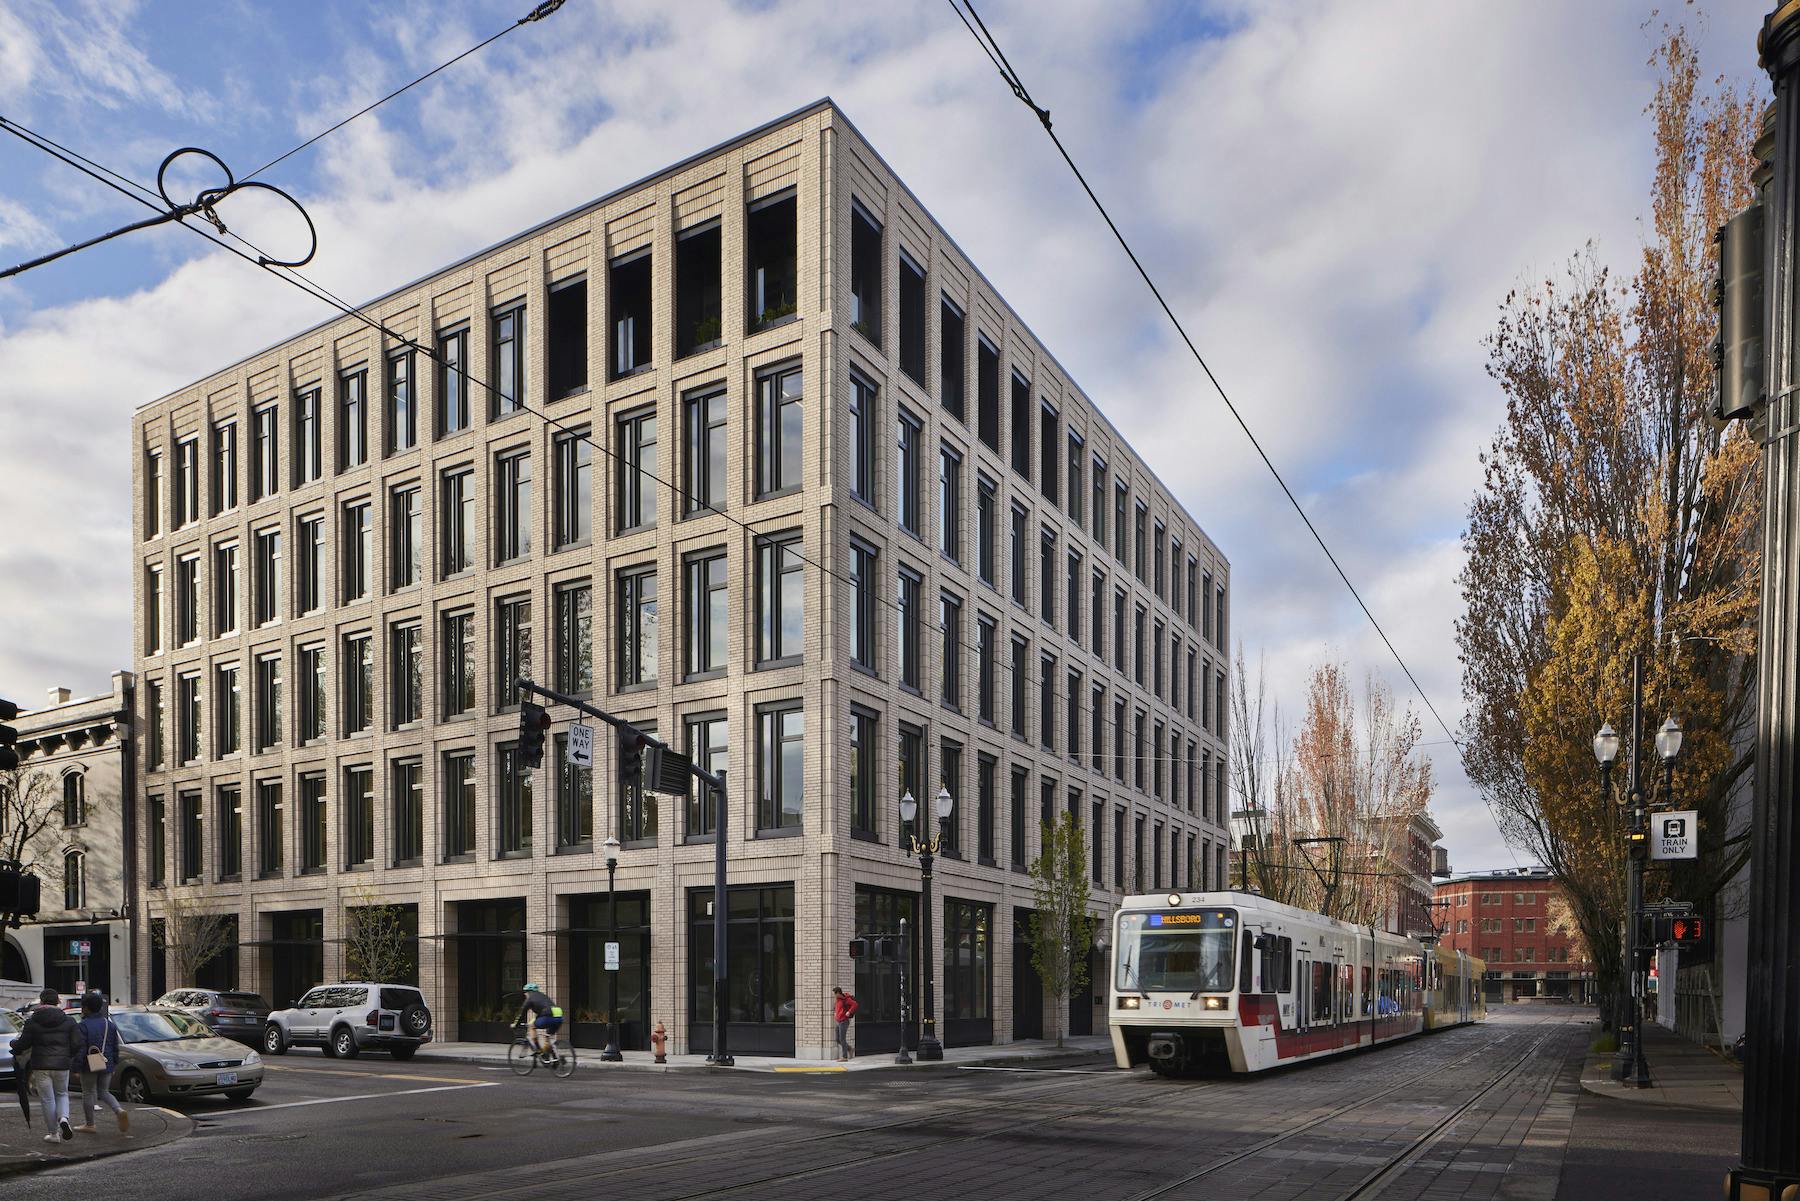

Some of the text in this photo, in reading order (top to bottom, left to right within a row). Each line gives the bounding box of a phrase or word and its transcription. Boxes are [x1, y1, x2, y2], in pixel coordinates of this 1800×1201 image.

[573, 726, 589, 738] ONE
[572, 737, 590, 749] WAY
[1661, 838, 1688, 846] TRAIN
[1662, 846, 1686, 854] ONLY
